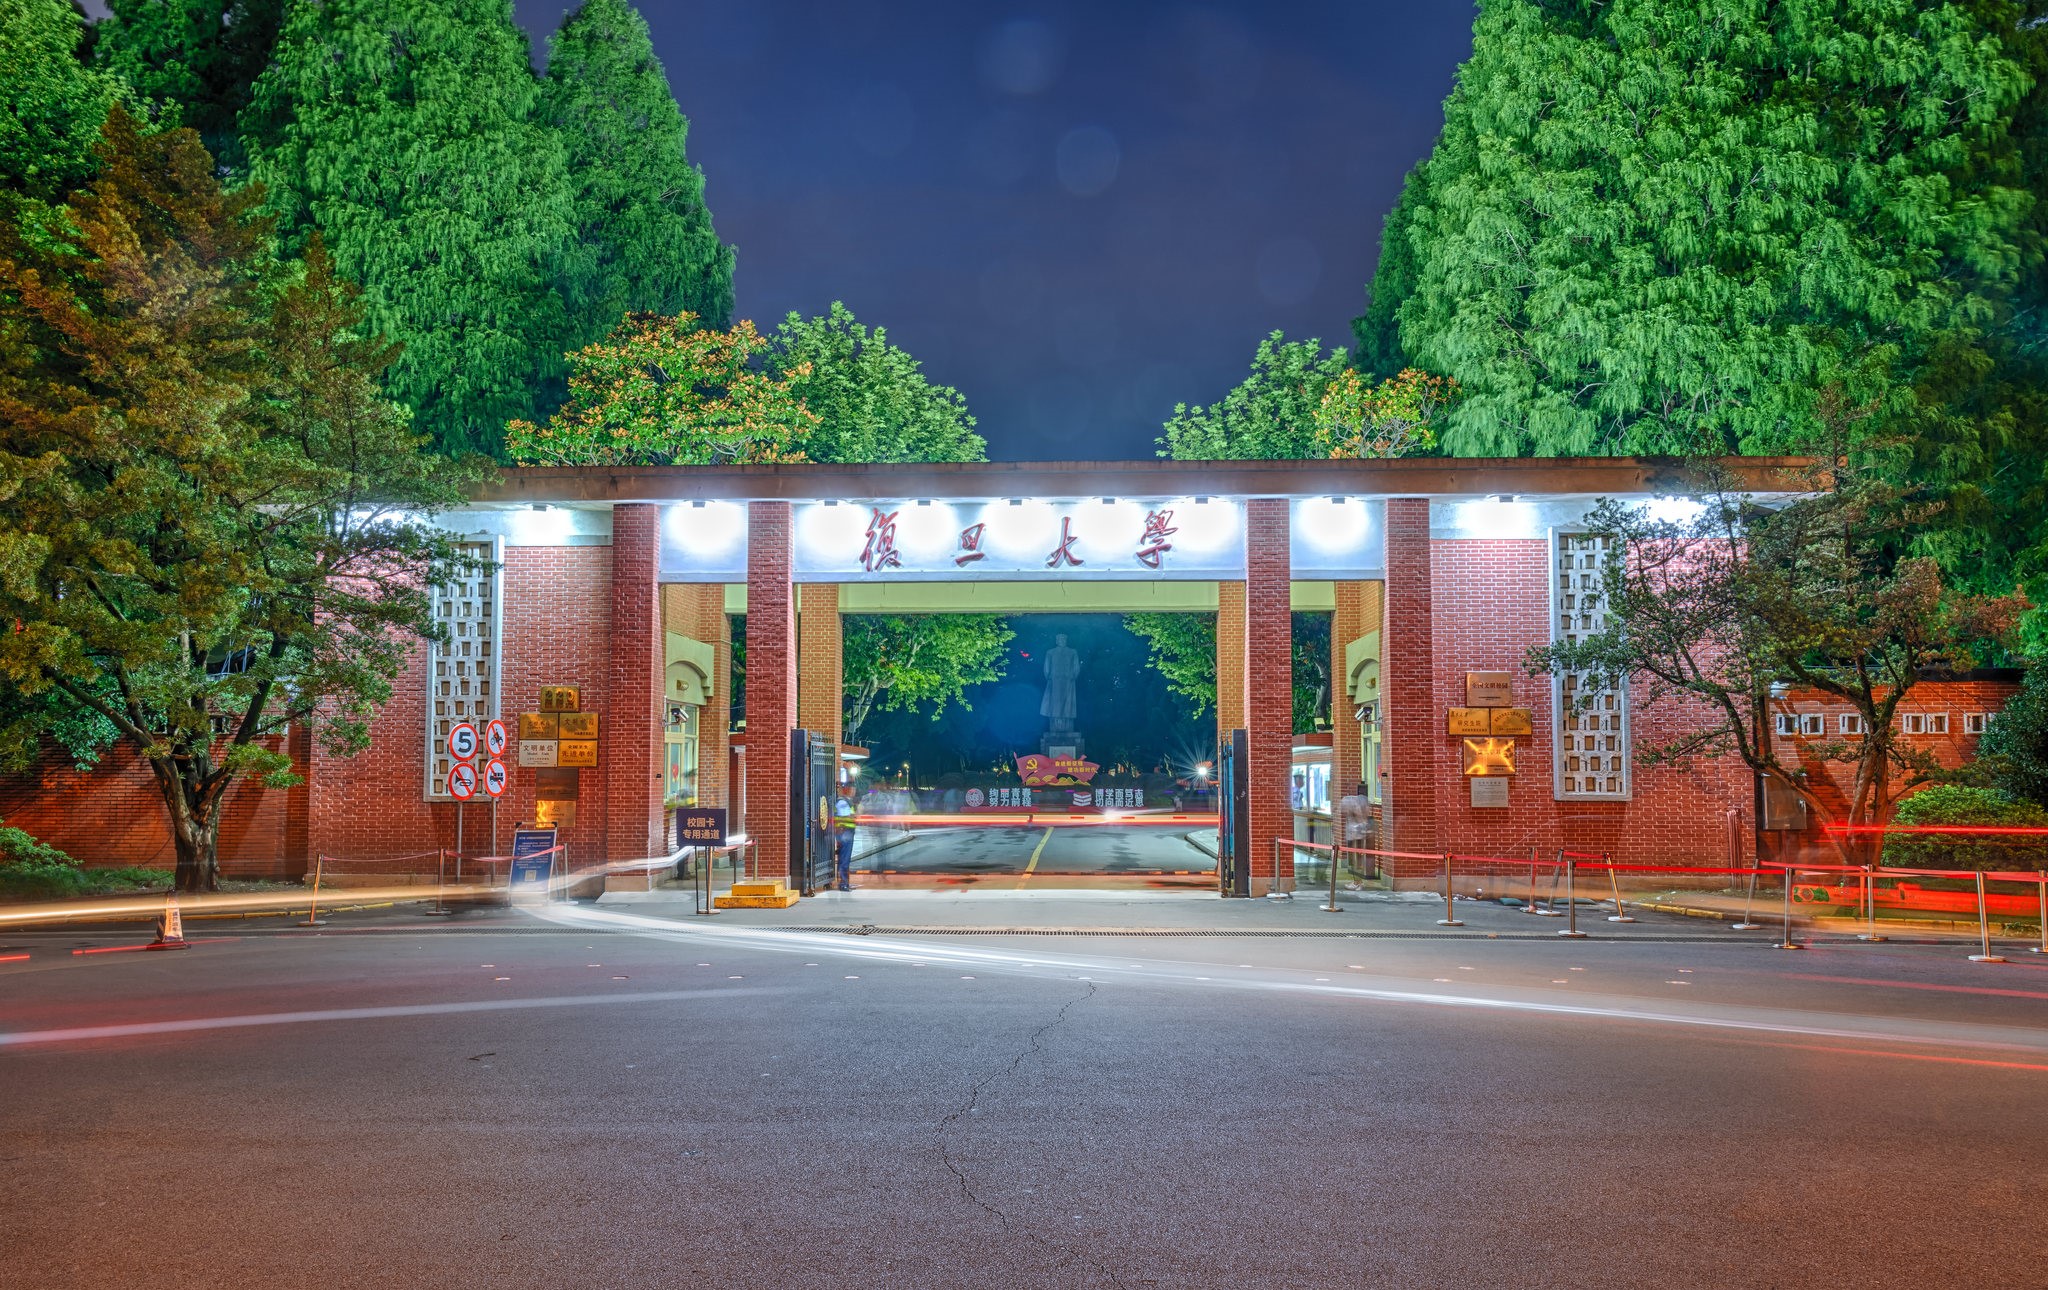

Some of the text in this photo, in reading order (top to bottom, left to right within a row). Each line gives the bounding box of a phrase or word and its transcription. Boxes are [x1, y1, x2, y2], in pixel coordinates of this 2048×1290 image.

[458, 731, 472, 753] 5
[1095, 788, 1144, 799] 博学而笃志
[1095, 799, 1144, 807] 切问而近思
[687, 817, 715, 828] 校园卡
[682, 829, 720, 839] 专用通道
